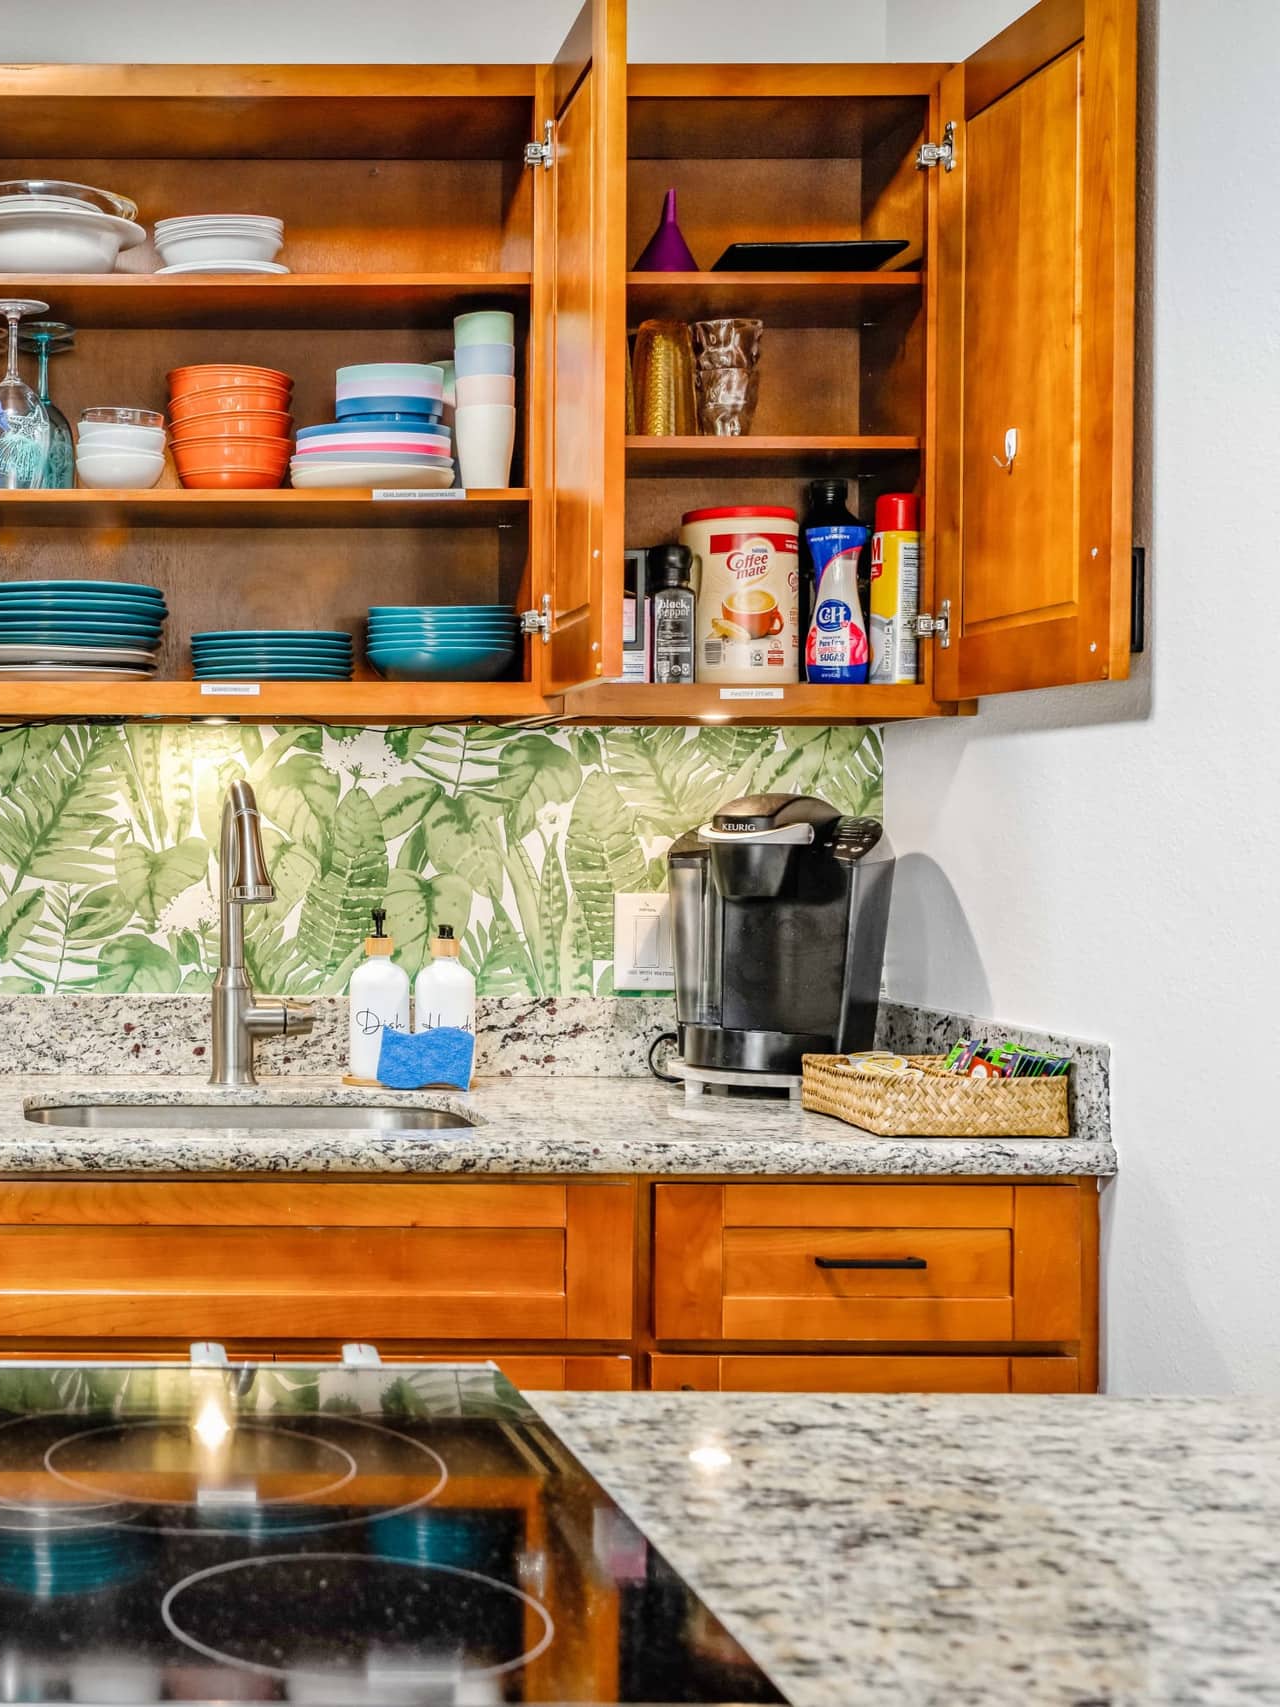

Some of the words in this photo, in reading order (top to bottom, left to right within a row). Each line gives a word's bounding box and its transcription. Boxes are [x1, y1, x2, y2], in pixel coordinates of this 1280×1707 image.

[726, 552, 768, 572] Coffee
[736, 565, 766, 579] mate
[659, 599, 688, 609] black
[657, 609, 689, 619] pepper
[818, 606, 847, 624] C&H
[820, 653, 845, 662] SUGAR
[721, 823, 756, 832] KEURIG
